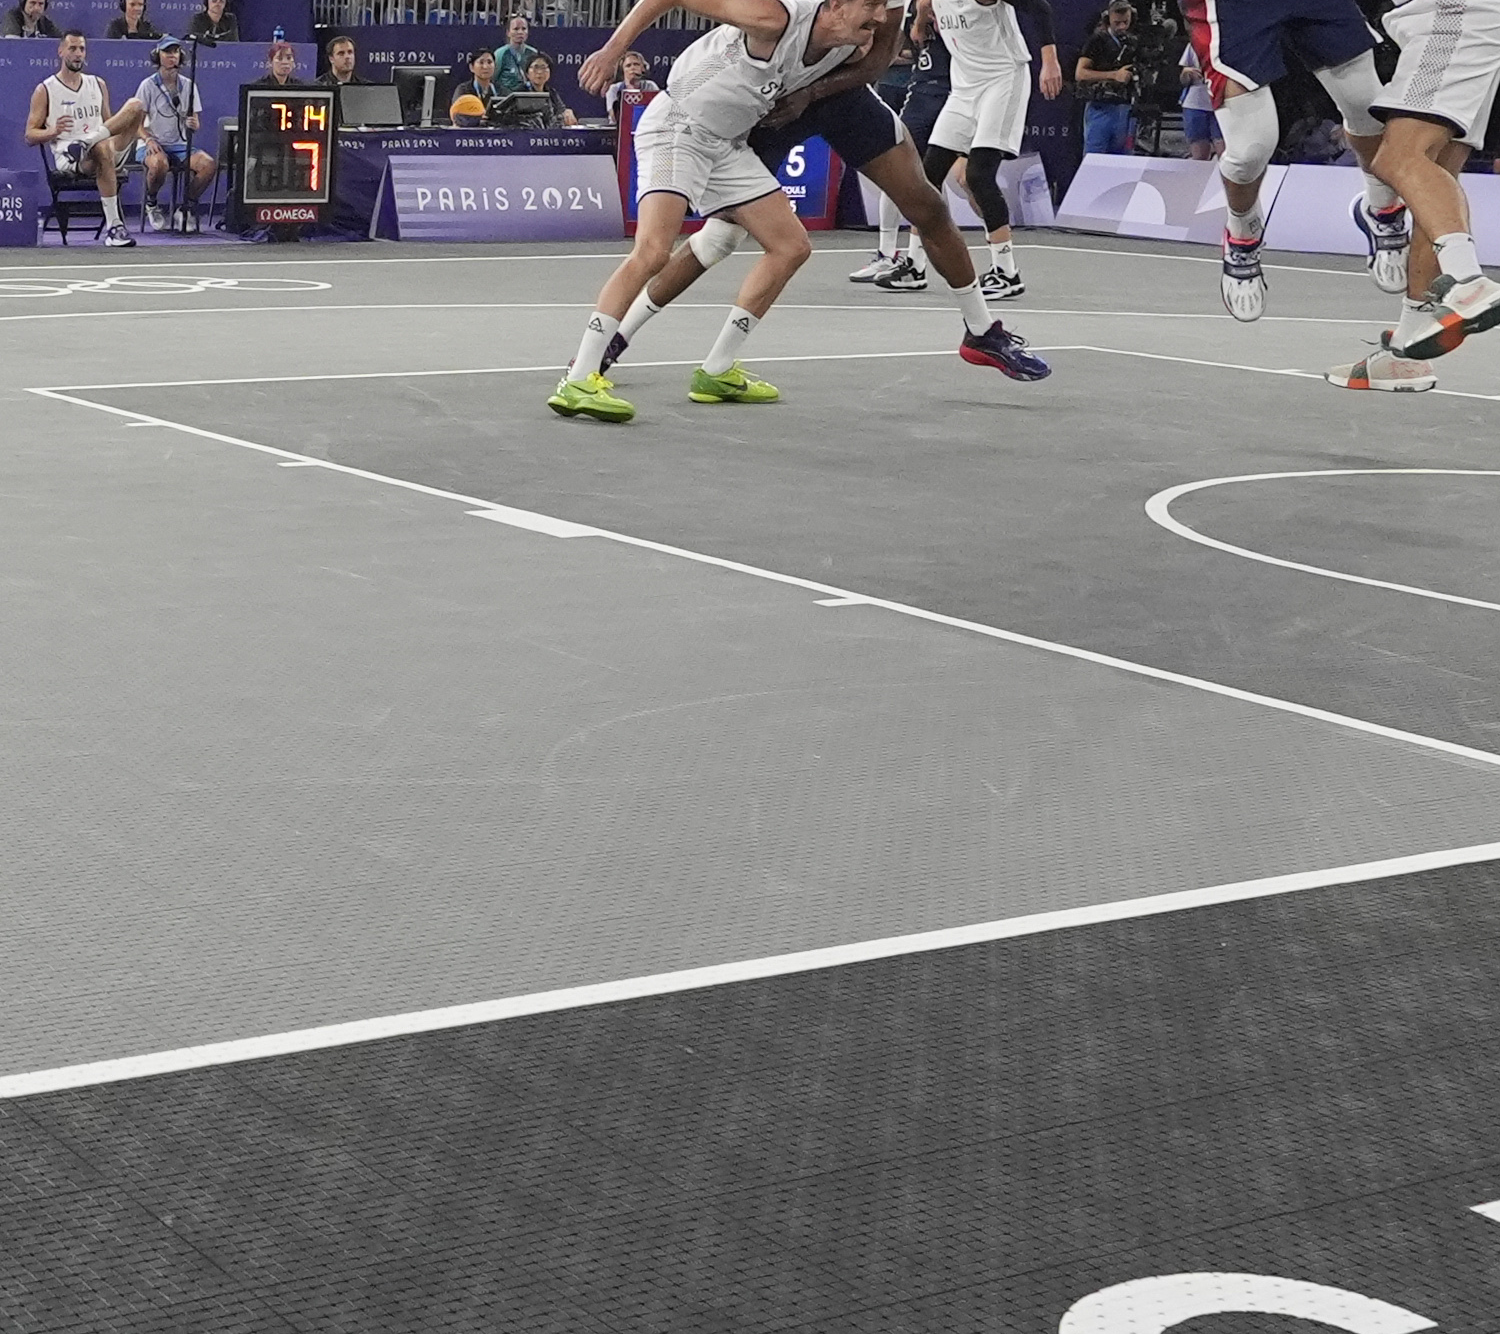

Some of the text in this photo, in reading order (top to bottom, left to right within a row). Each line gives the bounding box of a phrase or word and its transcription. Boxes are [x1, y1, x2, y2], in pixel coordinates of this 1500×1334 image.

[369, 51, 435, 63] PARIS 2024
[105, 59, 134, 68] PARIS
[271, 103, 327, 132] 7:14
[381, 138, 440, 149] PARIS 2024
[455, 138, 513, 148] PARIS 2024
[529, 138, 559, 147] PARIS
[292, 142, 320, 192] 7
[785, 145, 806, 178] 5
[416, 187, 603, 211] PARIS 2024
[273, 208, 316, 221] OMEGA
